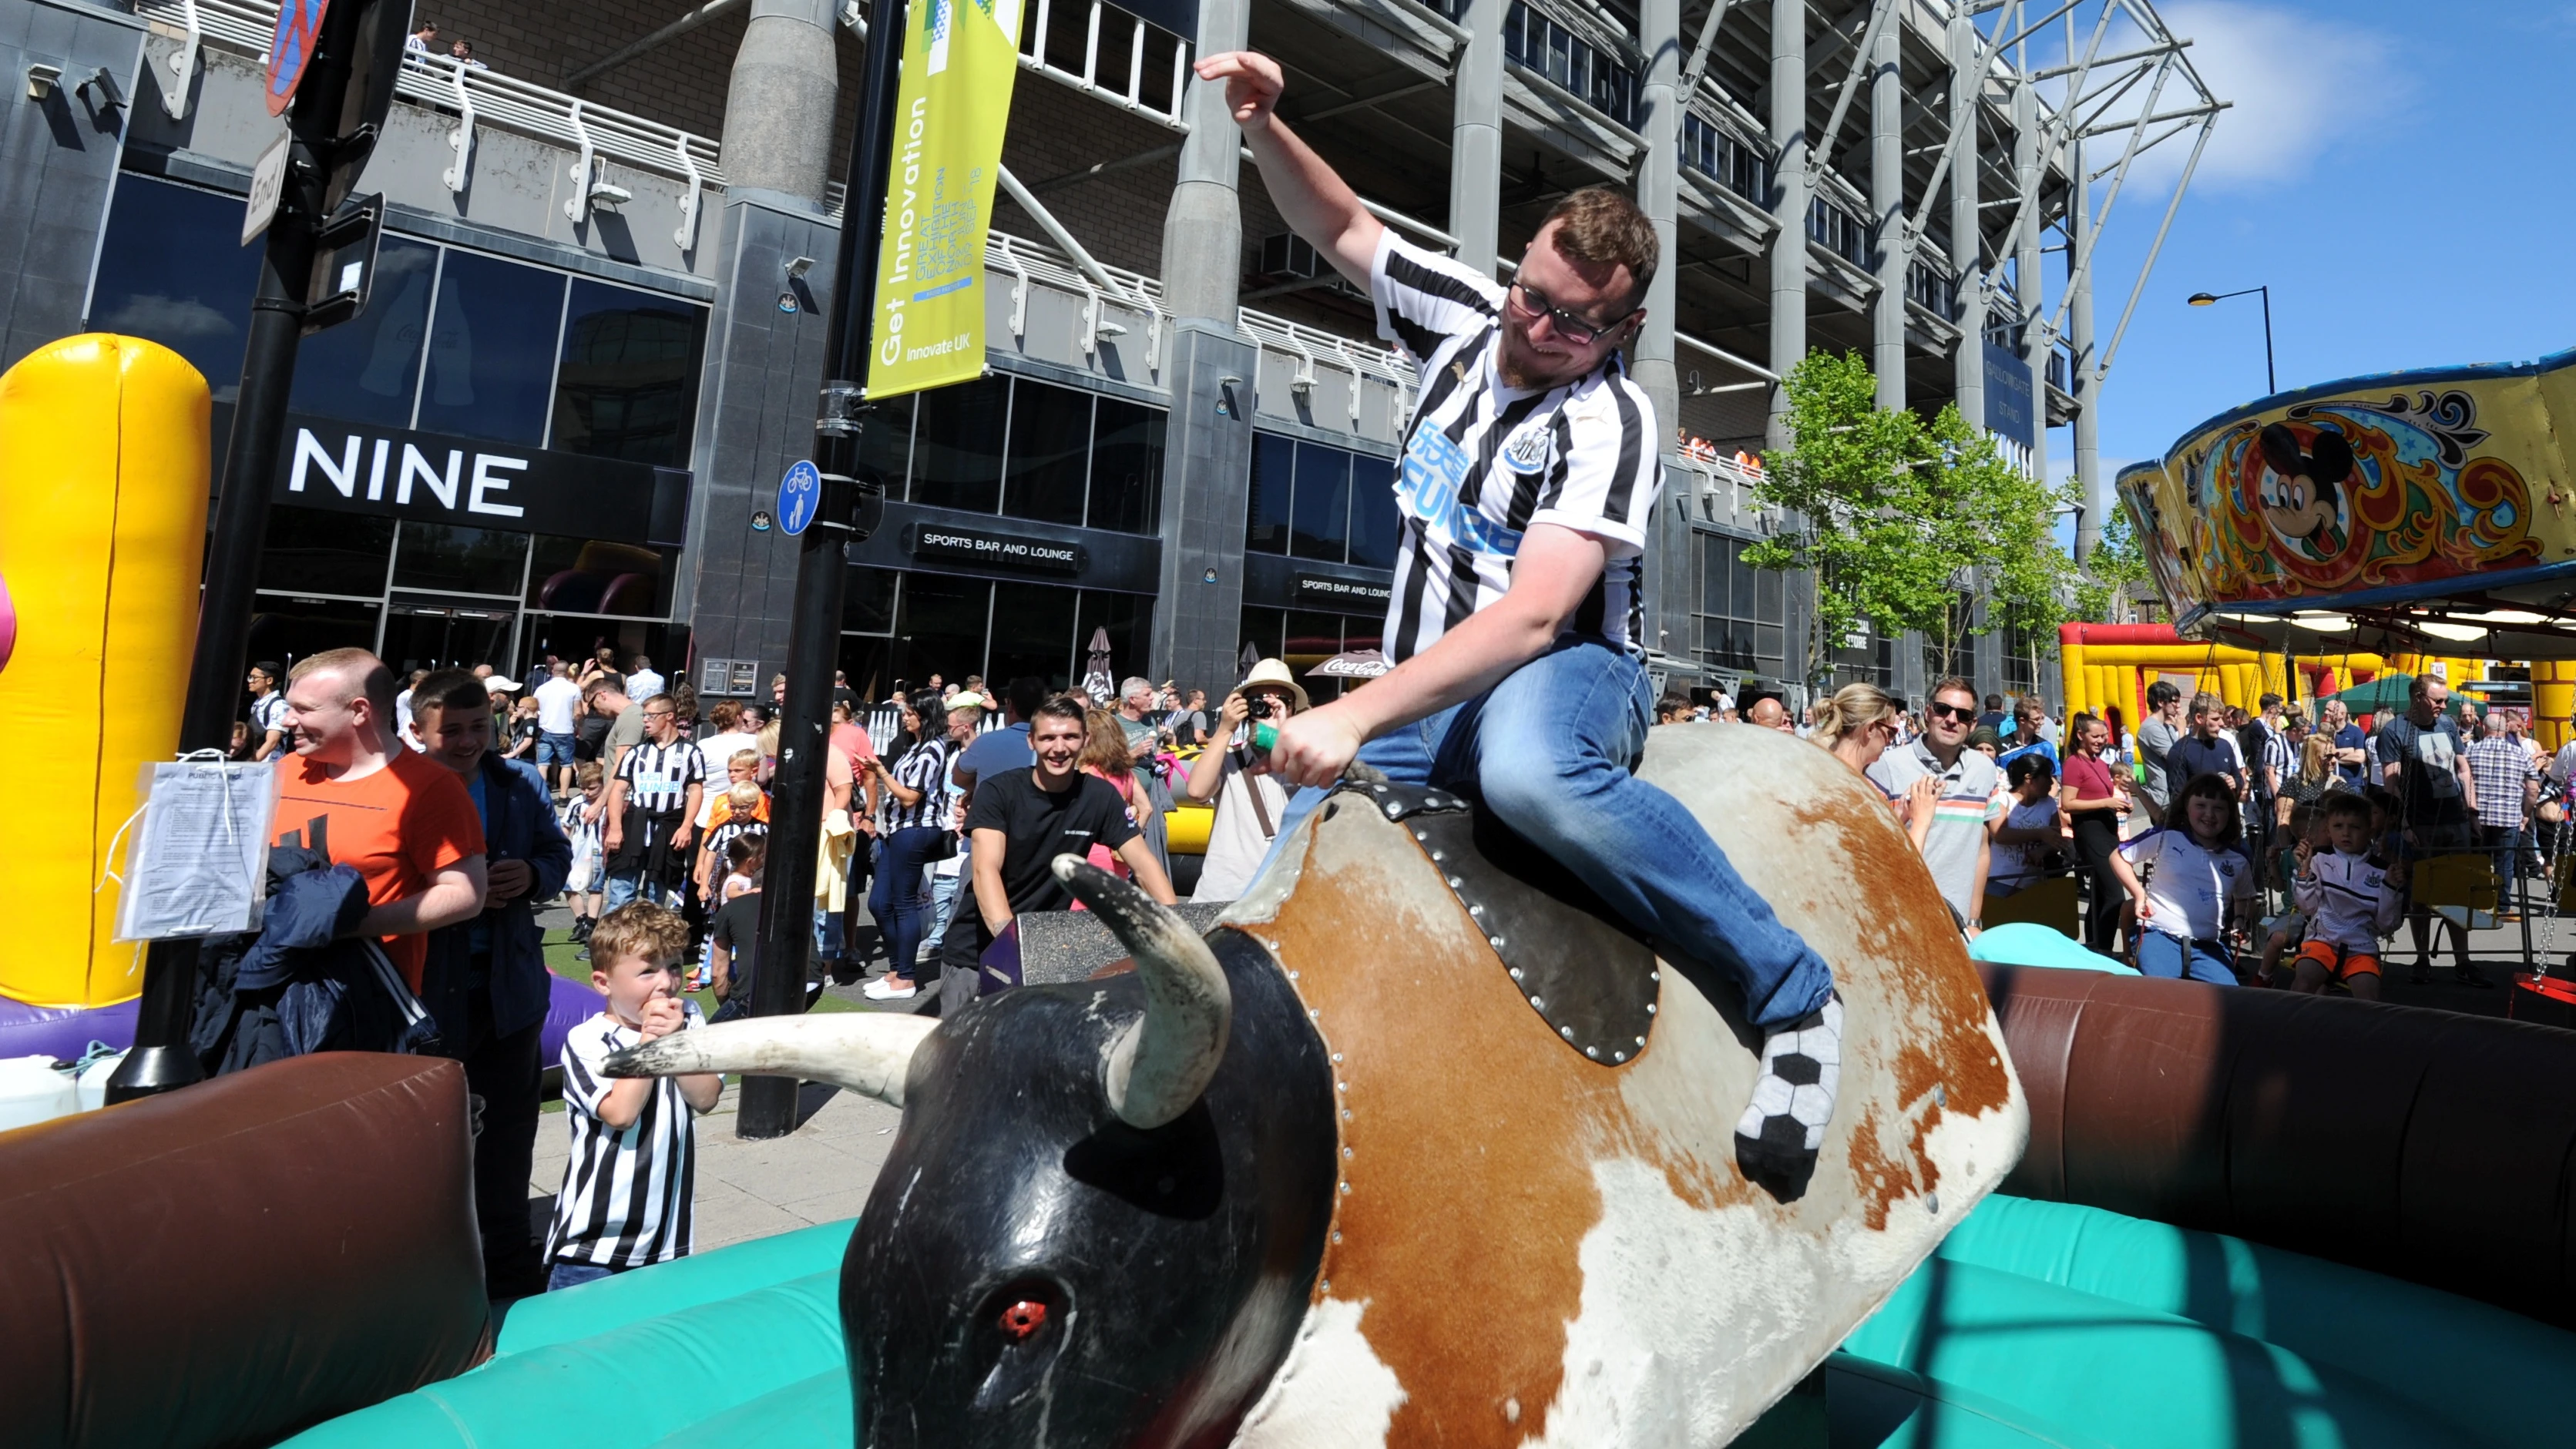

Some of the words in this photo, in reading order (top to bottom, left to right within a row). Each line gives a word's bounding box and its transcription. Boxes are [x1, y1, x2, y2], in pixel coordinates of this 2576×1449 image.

[251, 163, 278, 215] End
[888, 96, 926, 284] Innovation
[926, 166, 945, 280] EXHIBITION
[938, 202, 951, 240] THE
[946, 201, 960, 273] NORTH
[915, 216, 931, 281] GREAT
[936, 250, 946, 276] OF
[881, 298, 905, 366] Get
[906, 340, 953, 362] Innovate
[954, 333, 970, 351] UK
[1986, 361, 2030, 397] GALLOWGATE
[1999, 401, 2019, 424] STAND
[289, 428, 528, 517] NINE
[924, 533, 972, 548] SPORTS
[975, 540, 1000, 552] BAR
[1003, 544, 1027, 555] AND
[1031, 547, 1074, 561] LOUNGE
[1302, 579, 1332, 592] SPORTS
[1334, 584, 1349, 593] BAR
[1351, 586, 1366, 595] AND
[1369, 588, 1392, 599] LOUNG
[1845, 634, 1867, 649] STORE
